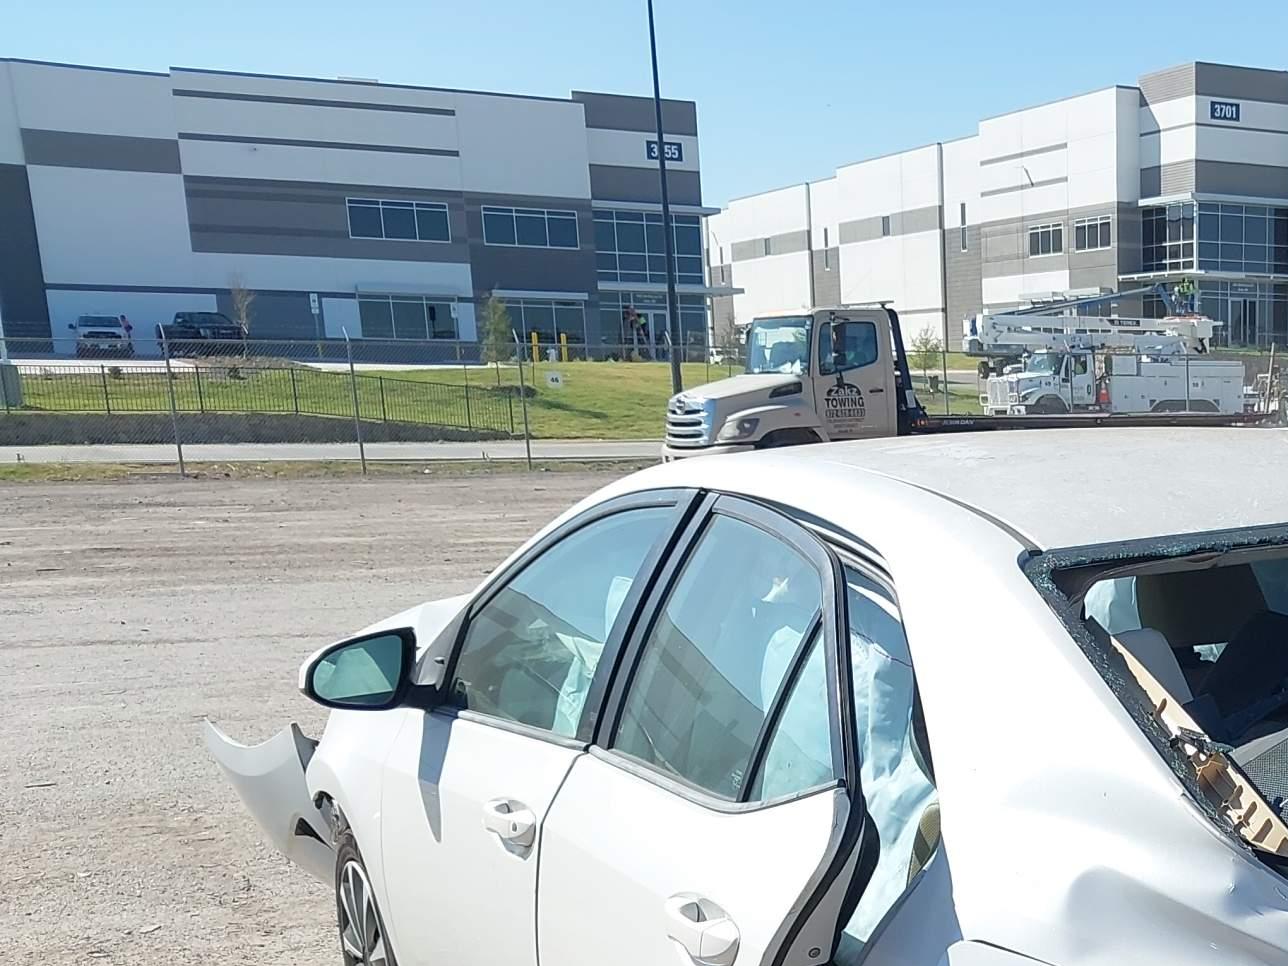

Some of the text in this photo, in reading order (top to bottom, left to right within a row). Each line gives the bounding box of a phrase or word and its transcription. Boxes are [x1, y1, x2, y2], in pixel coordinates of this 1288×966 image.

[1214, 104, 1236, 118] 3701
[650, 143, 679, 158] 355
[831, 386, 858, 396] Zakz
[824, 396, 865, 408] TOWING
